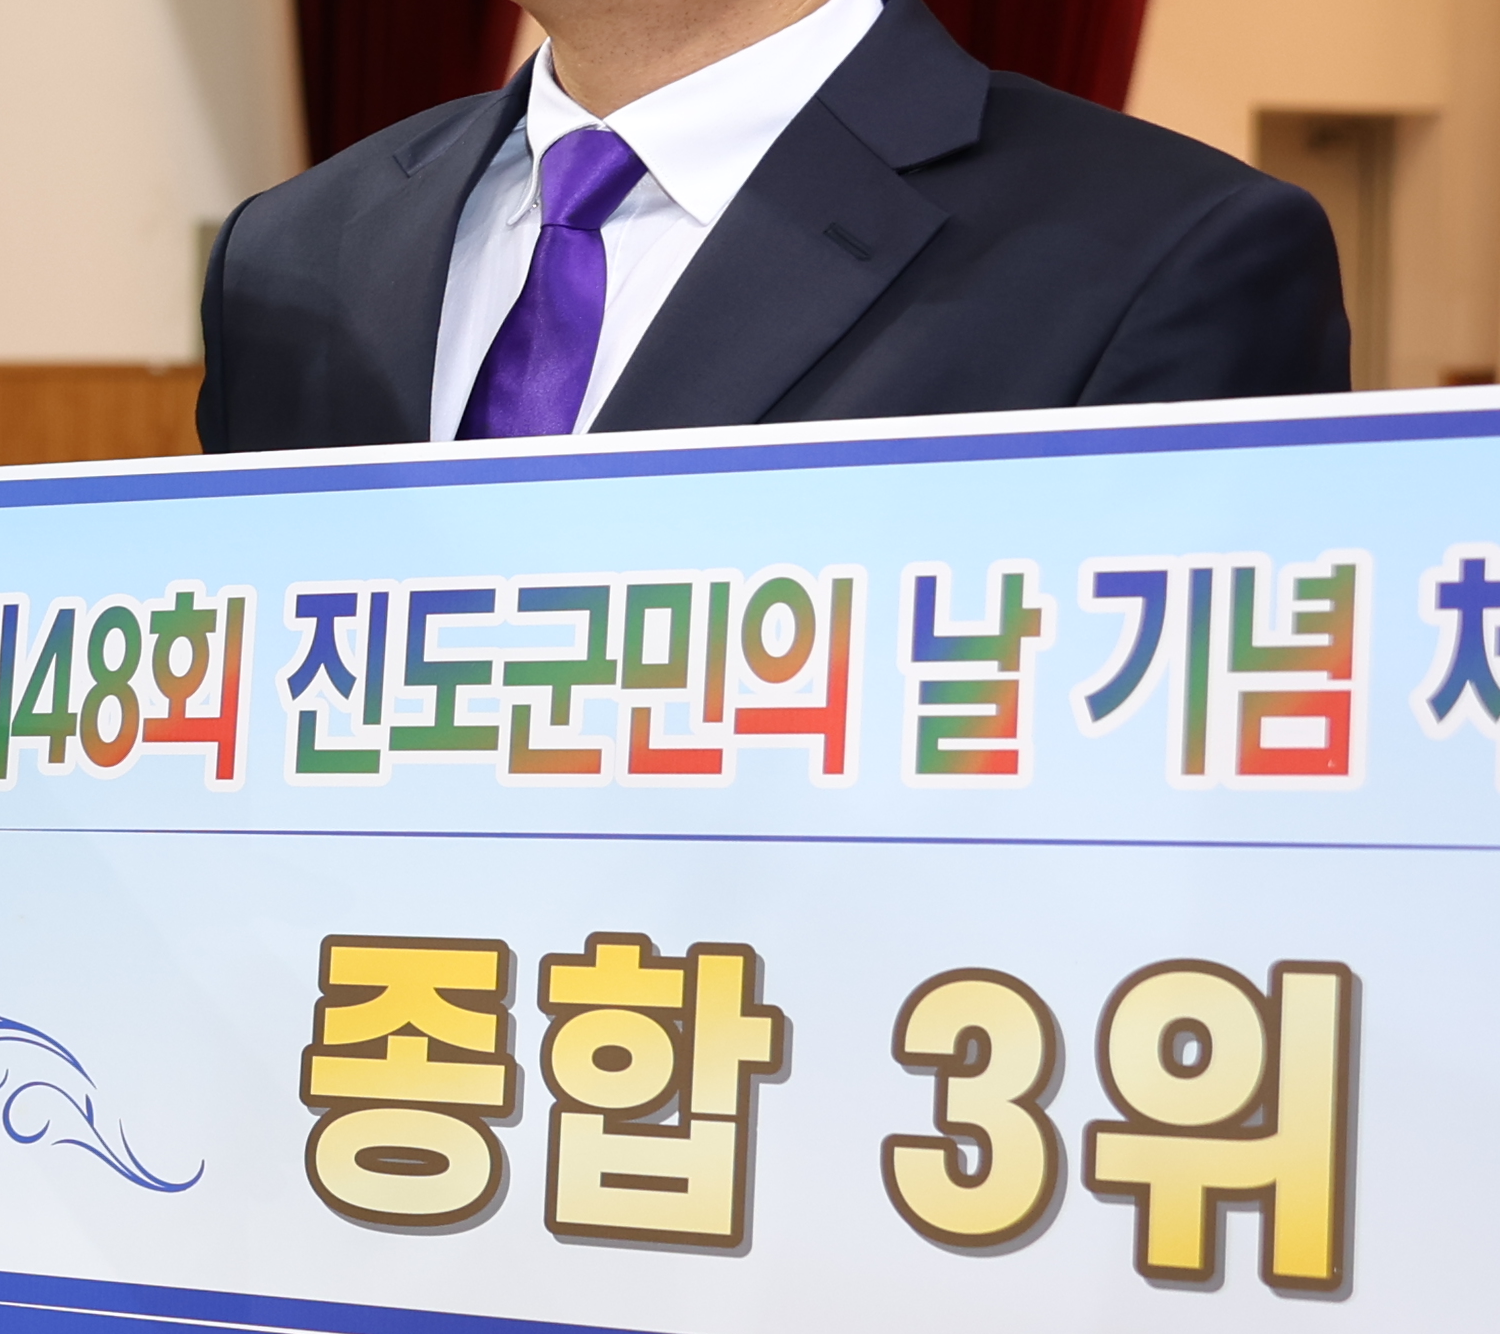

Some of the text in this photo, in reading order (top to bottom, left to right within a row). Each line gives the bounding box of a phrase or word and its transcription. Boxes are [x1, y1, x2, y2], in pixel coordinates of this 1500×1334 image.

[285, 577, 855, 777] 진도군민의
[916, 570, 1042, 776] 날
[1085, 563, 1357, 777] 기념
[300, 932, 1360, 1302] 종합 3위
